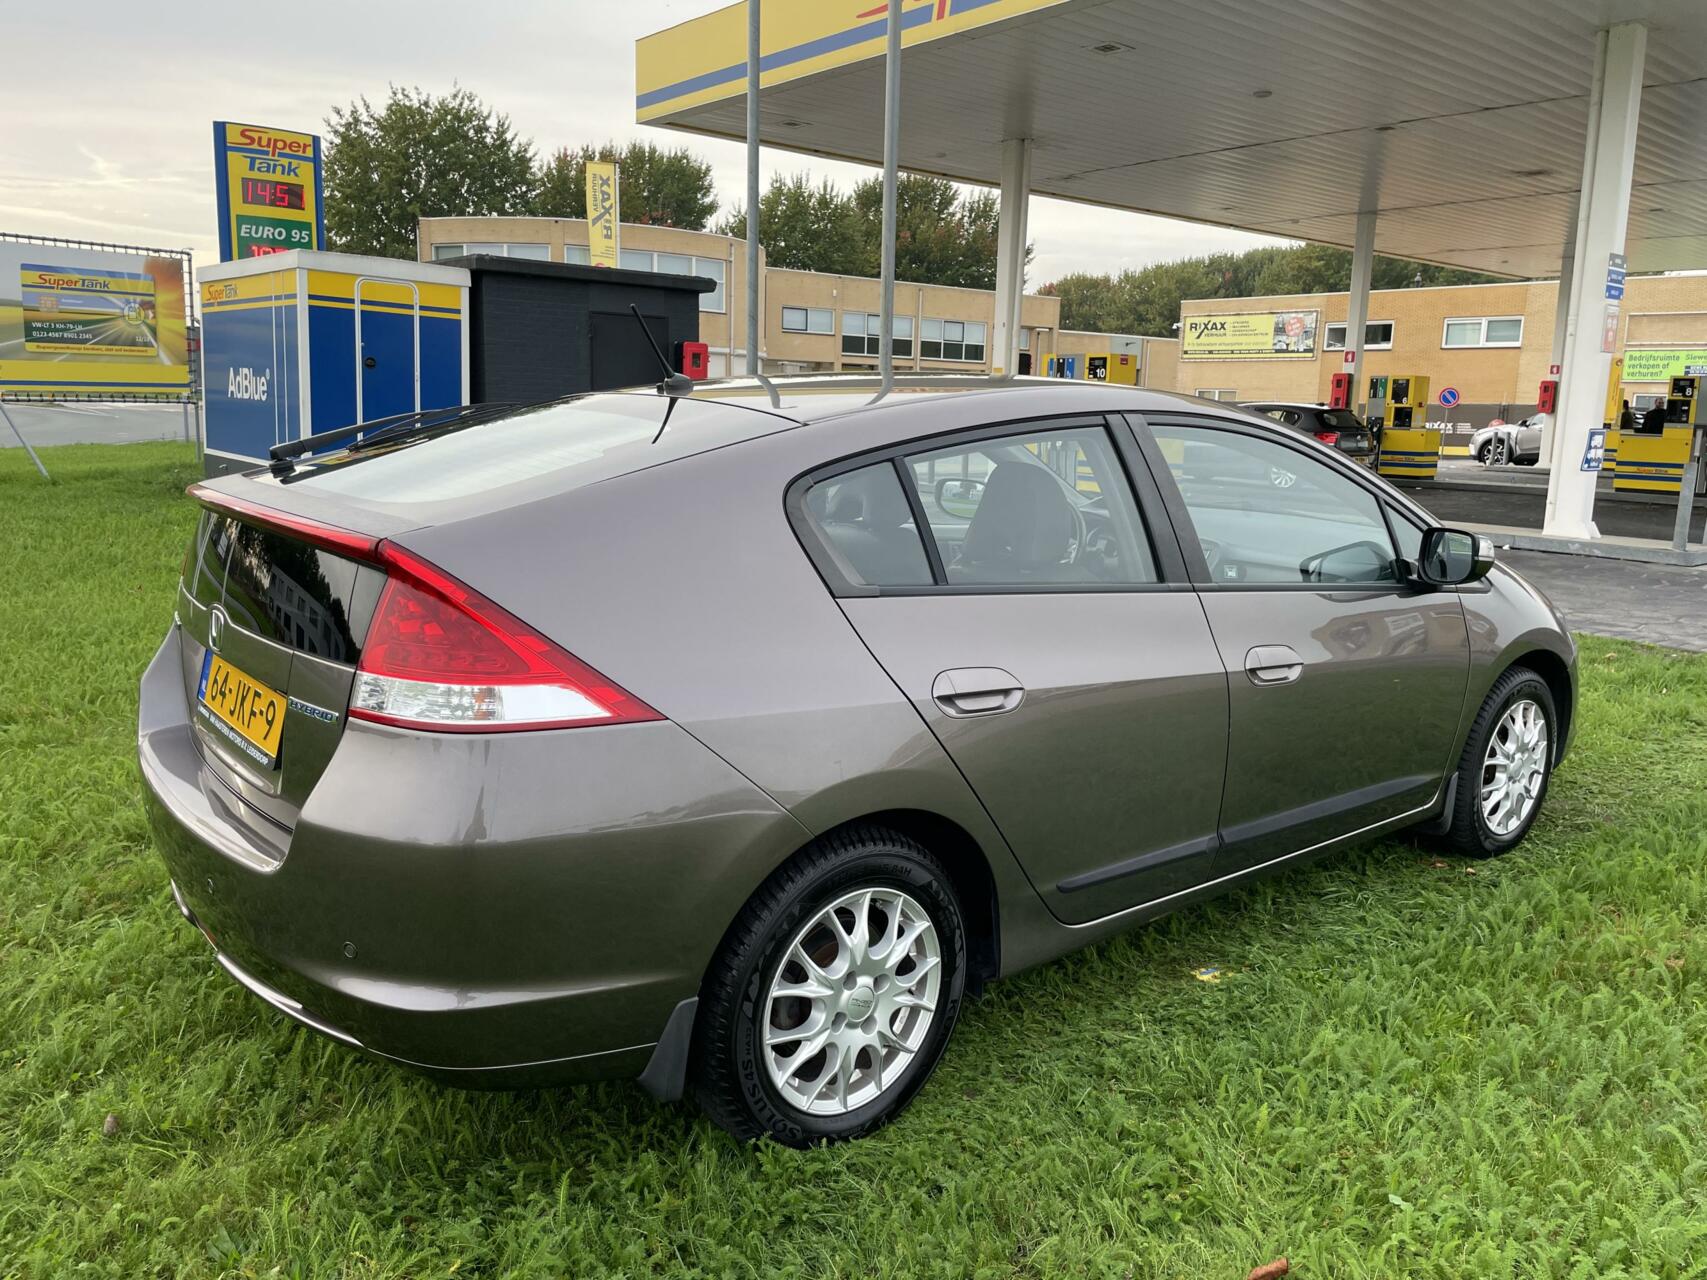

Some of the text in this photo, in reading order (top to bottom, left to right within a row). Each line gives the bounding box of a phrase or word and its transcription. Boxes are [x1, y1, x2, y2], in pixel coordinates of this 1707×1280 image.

[226, 128, 312, 158] Super
[240, 154, 300, 178] Tank
[240, 223, 310, 243] EURO 95
[1189, 320, 1227, 340] RIXAX
[1628, 354, 1680, 362] Bedrijfsruimte
[1628, 362, 1660, 371] verkopen
[1096, 368, 1105, 377] 10
[228, 367, 268, 401] AdBlue
[1686, 388, 1692, 396] 8
[210, 664, 277, 741] 64-JKF-9
[290, 699, 334, 722] HYBRID
